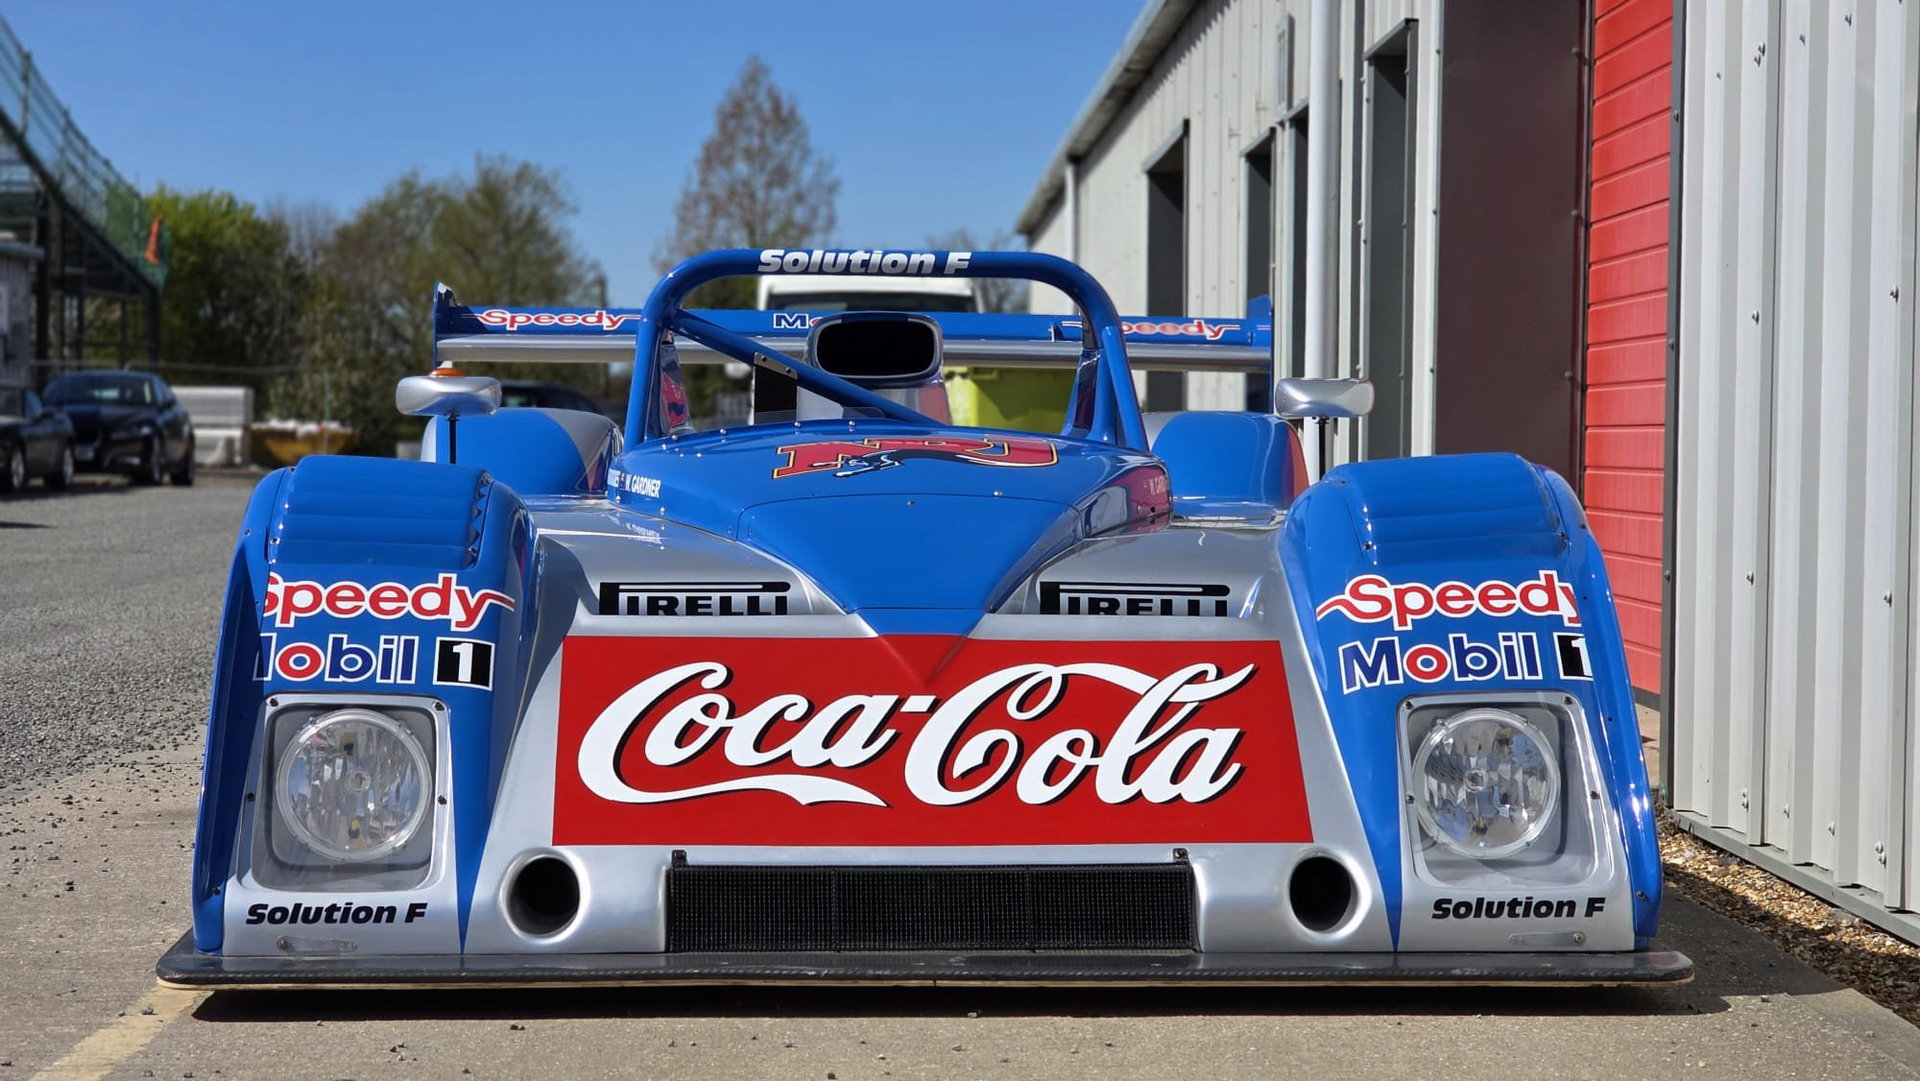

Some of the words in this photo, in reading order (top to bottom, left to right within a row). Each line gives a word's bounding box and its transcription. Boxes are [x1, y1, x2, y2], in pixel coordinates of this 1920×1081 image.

[758, 249, 935, 274] Solution
[944, 251, 972, 274] F
[461, 309, 641, 331] Speedy
[599, 581, 791, 616] PIRELLI
[253, 632, 419, 684] obil
[1338, 632, 1544, 694] Mobil
[577, 661, 1259, 807] Coca-Cola
[245, 900, 397, 925] Solution
[404, 902, 427, 924] F
[1431, 896, 1577, 920] Solution
[1584, 896, 1606, 918] F
